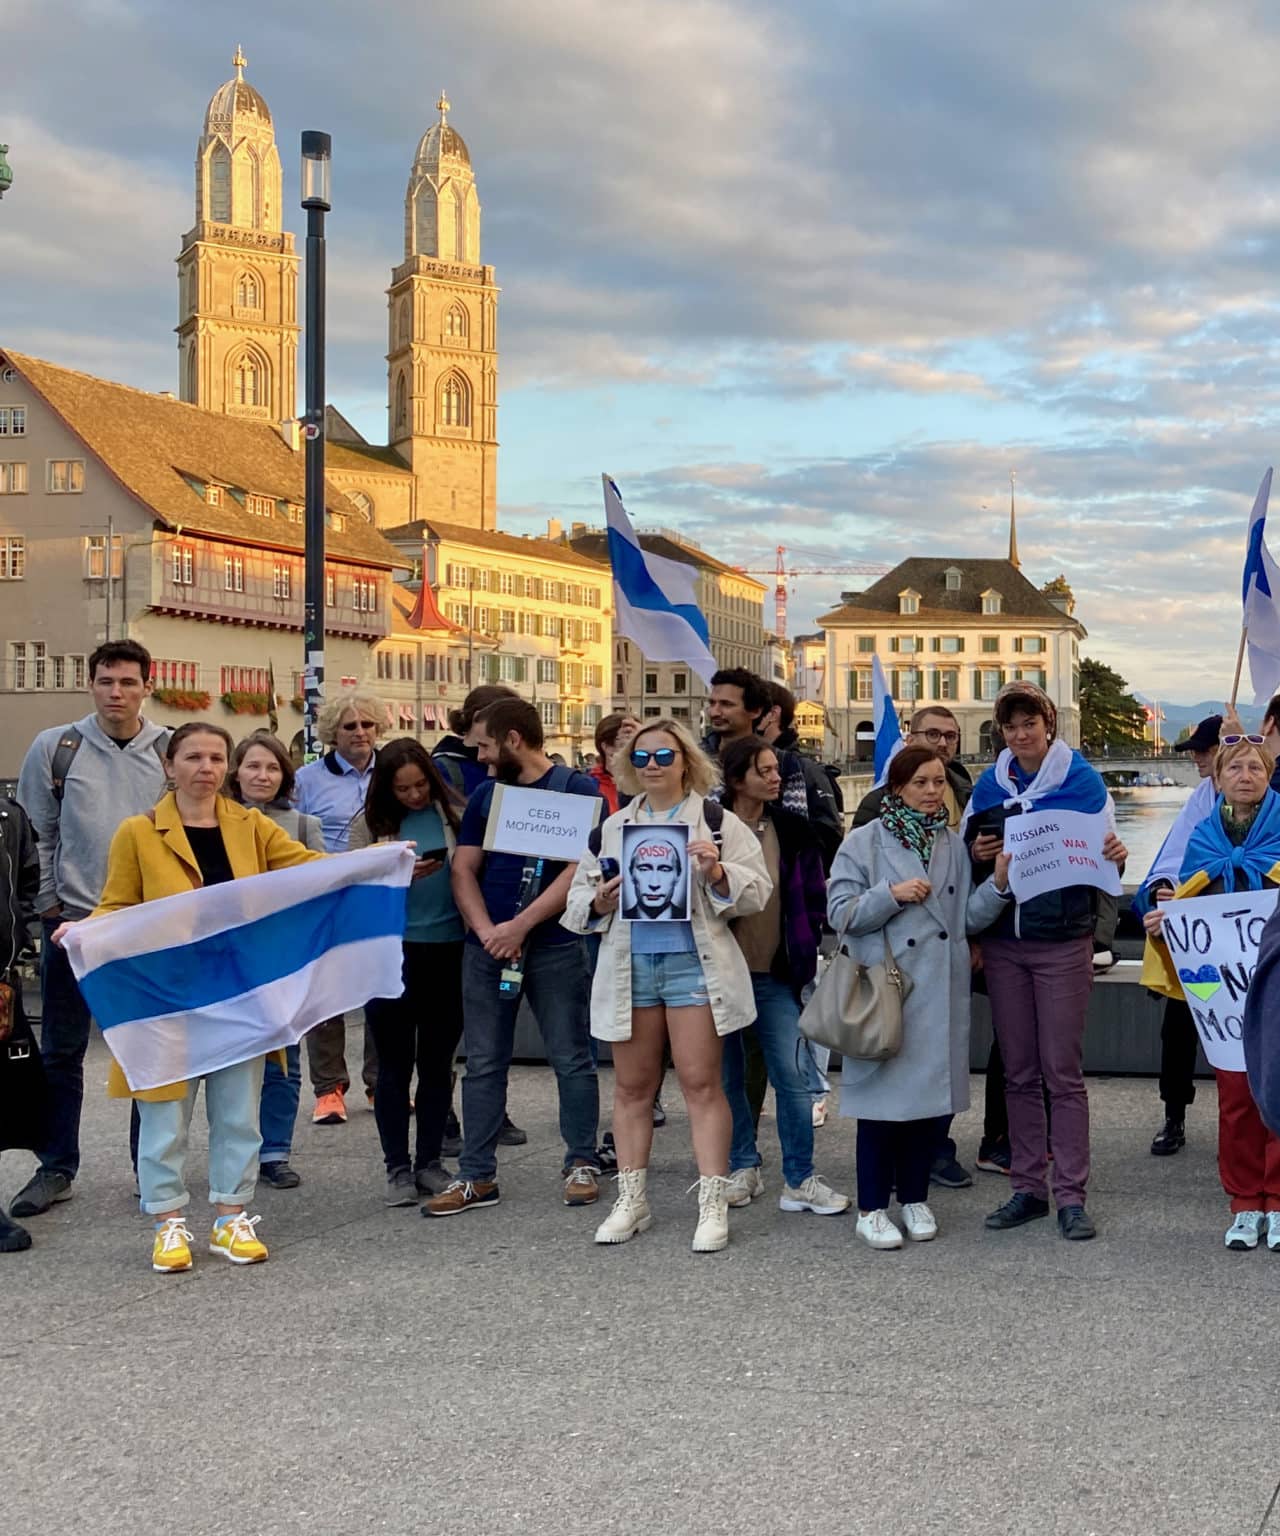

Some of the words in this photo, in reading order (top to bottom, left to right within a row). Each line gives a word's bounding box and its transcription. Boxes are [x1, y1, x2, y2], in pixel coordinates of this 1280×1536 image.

[528, 807, 561, 821] СЕБЯ
[505, 821, 578, 838] МОГИЛИЗУЙ
[1010, 823, 1060, 843] RUSSIANS
[638, 845, 673, 860] PUSSY
[1014, 842, 1056, 863] AGAINST
[1062, 839, 1088, 850] WAR
[1020, 859, 1061, 880] AGAINST
[1068, 855, 1098, 870] PUTIN
[1162, 913, 1212, 954] NO
[1222, 909, 1267, 953] TO
